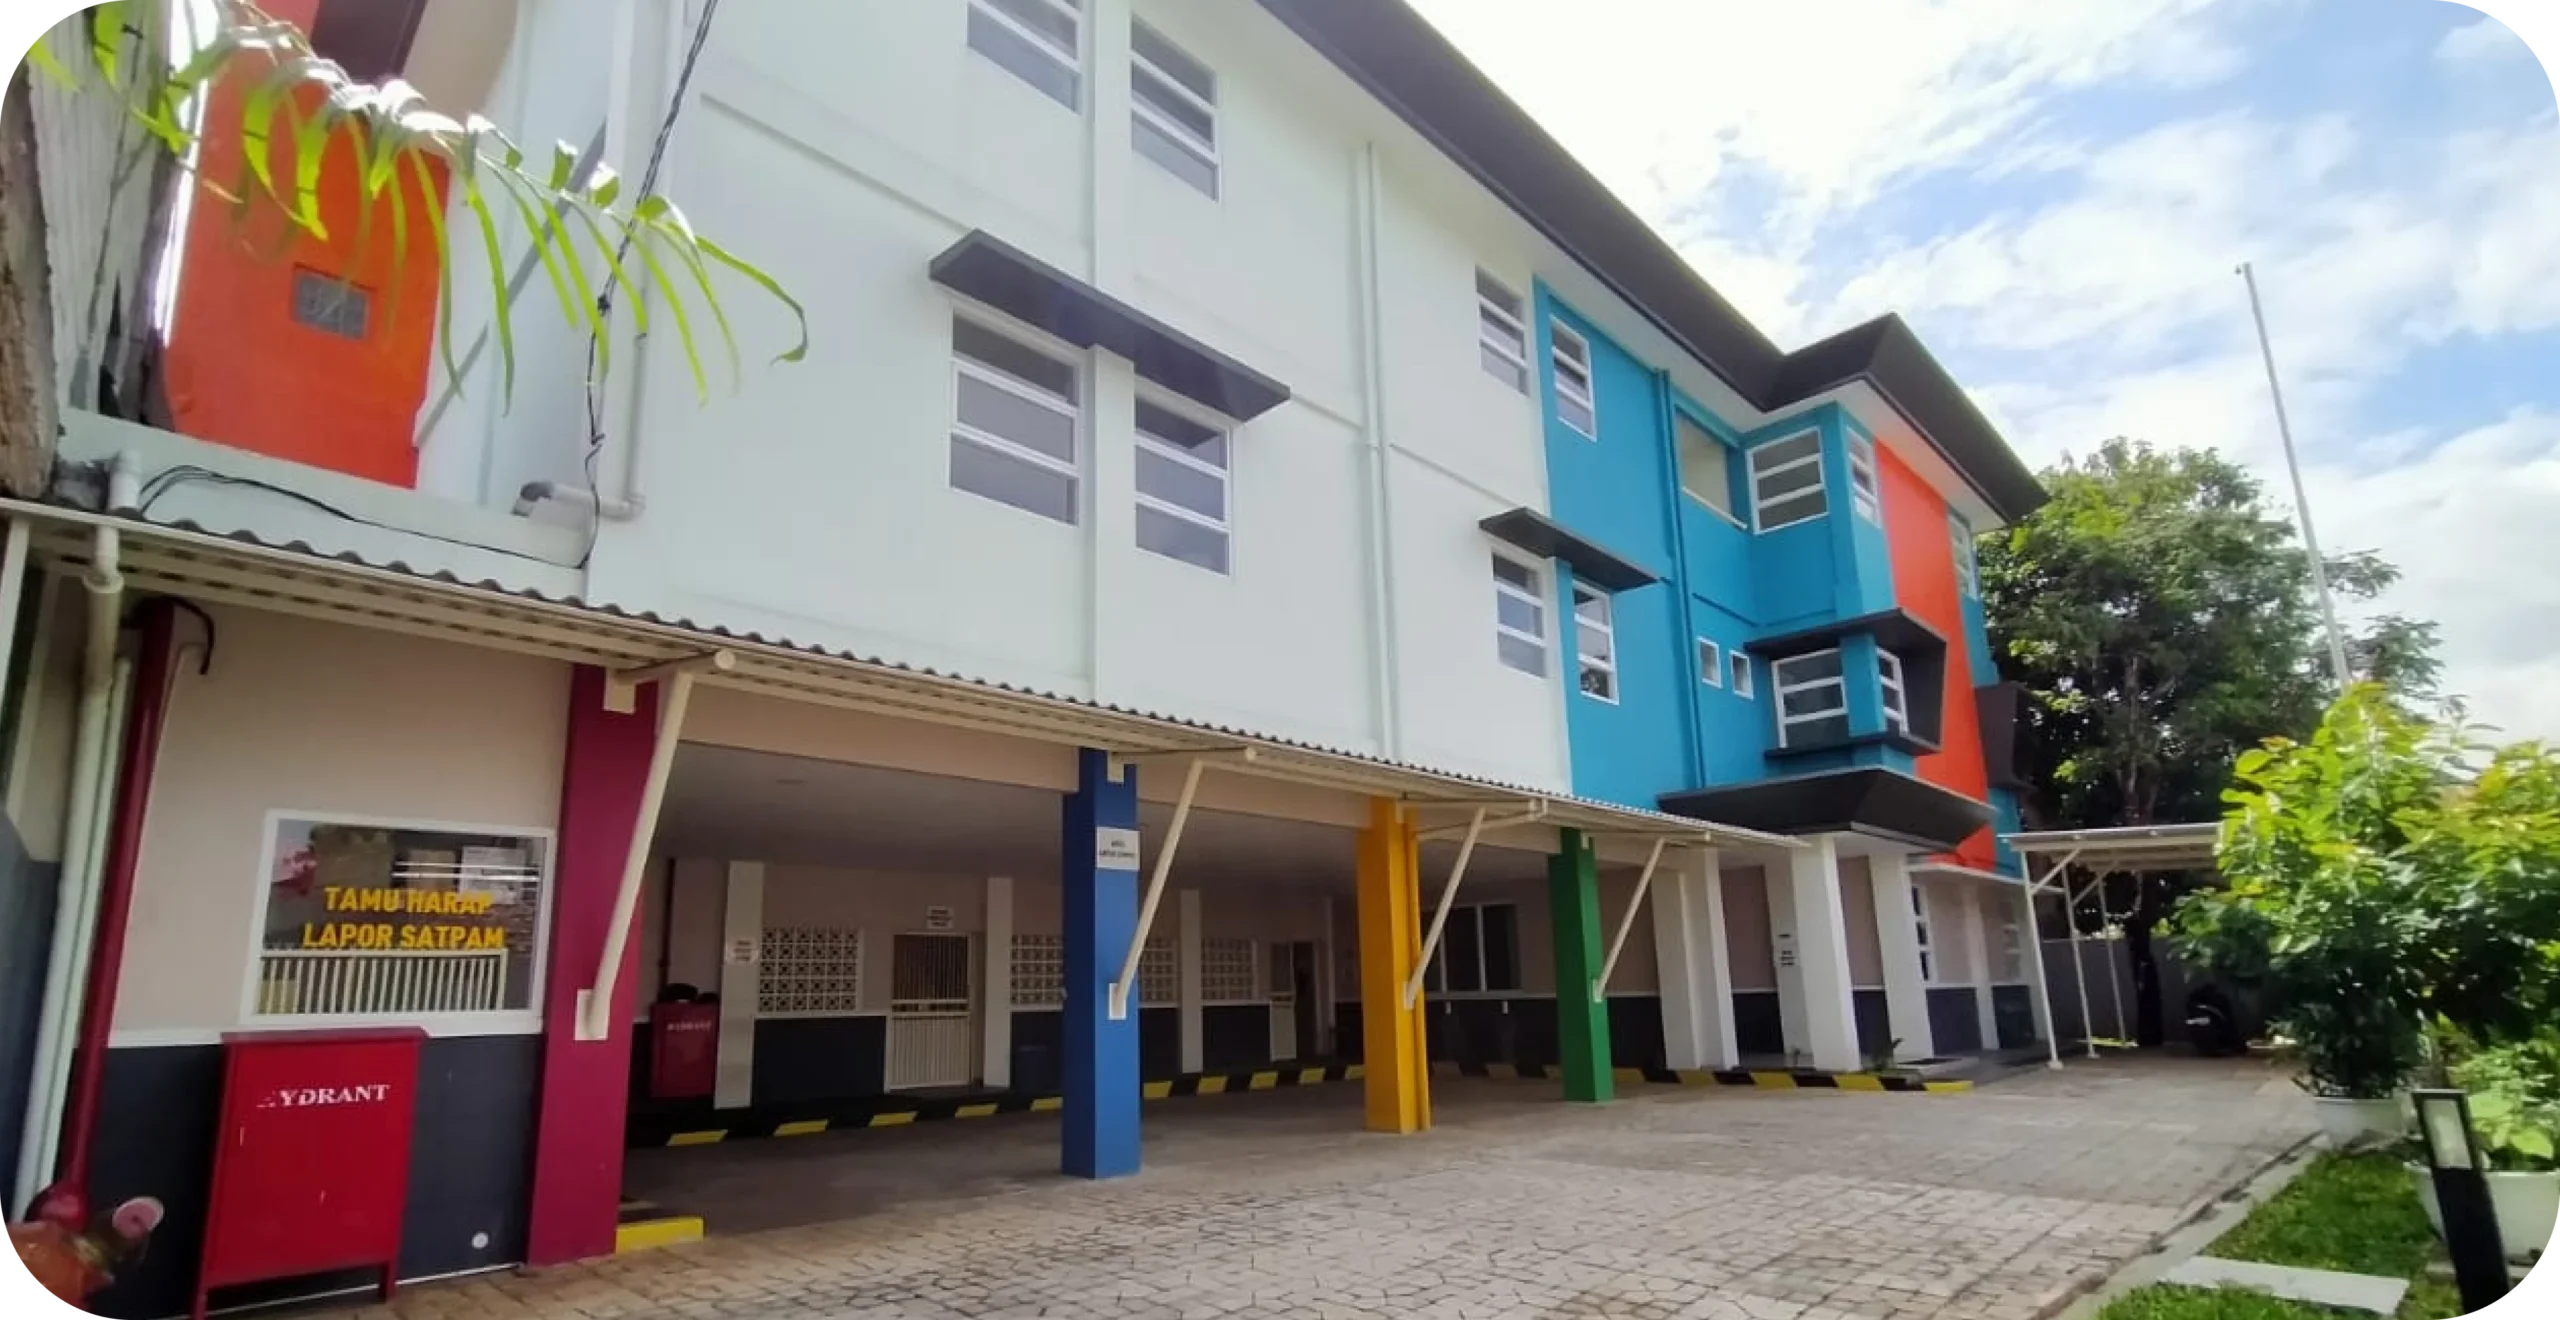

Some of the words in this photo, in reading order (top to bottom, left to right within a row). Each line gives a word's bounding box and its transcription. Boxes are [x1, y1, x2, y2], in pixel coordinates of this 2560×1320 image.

[324, 887, 399, 912] TAMU
[406, 889, 493, 915] HARAP
[303, 921, 394, 948] LAPOR
[400, 925, 505, 949] SATPAM
[256, 1084, 391, 1108] YDRANT
